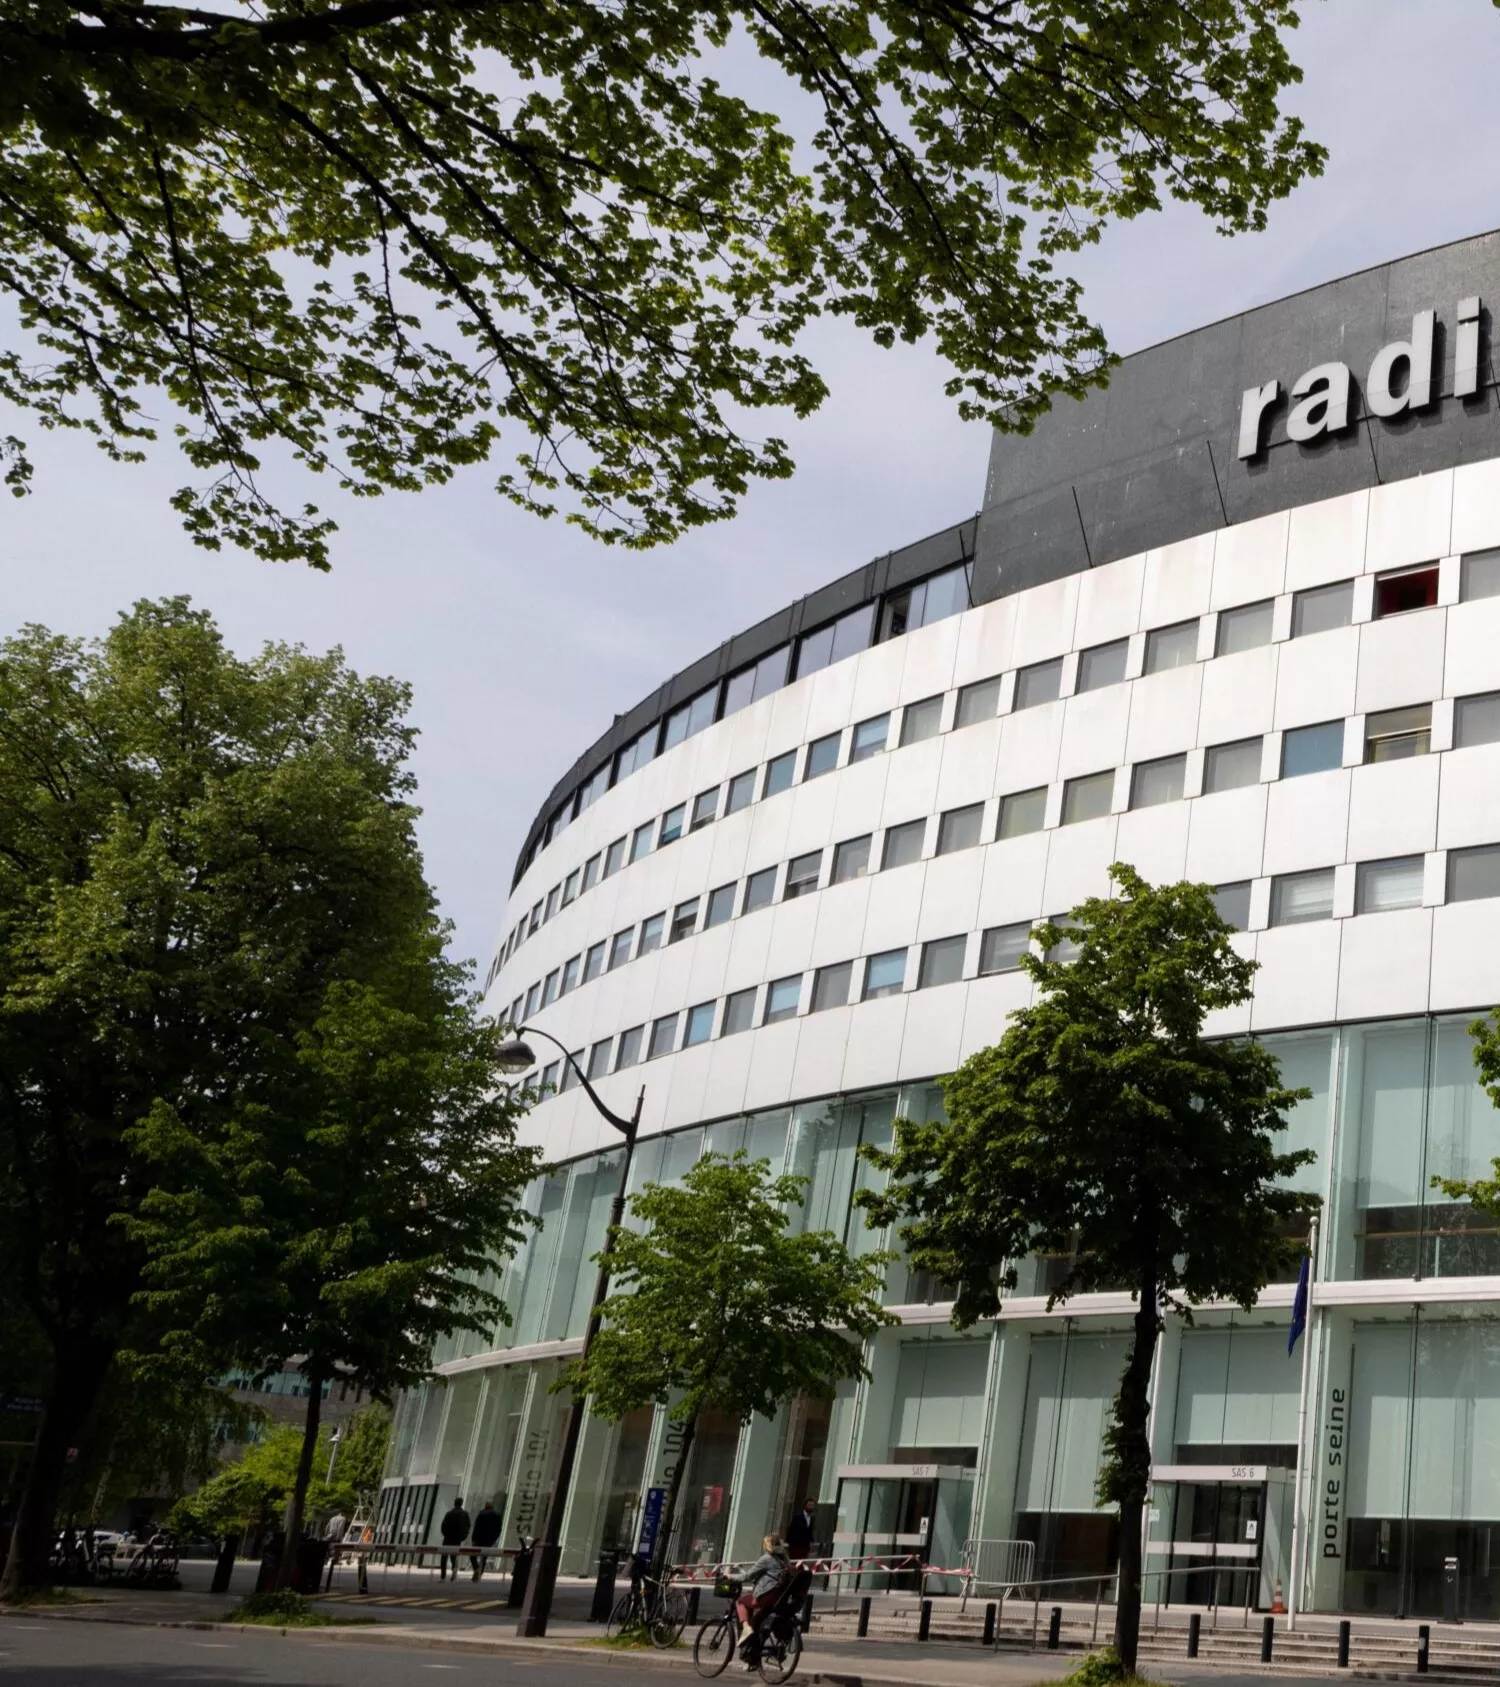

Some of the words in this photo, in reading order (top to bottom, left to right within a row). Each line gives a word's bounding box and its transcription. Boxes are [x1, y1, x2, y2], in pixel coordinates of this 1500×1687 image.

[663, 1421, 687, 1455] 104
[1325, 1388, 1345, 1466] seine
[912, 1466, 924, 1476] SAS
[1231, 1467, 1247, 1478] SAS
[1249, 1468, 1255, 1478] 6
[517, 1470, 541, 1534] studio
[1323, 1479, 1341, 1559] porte
